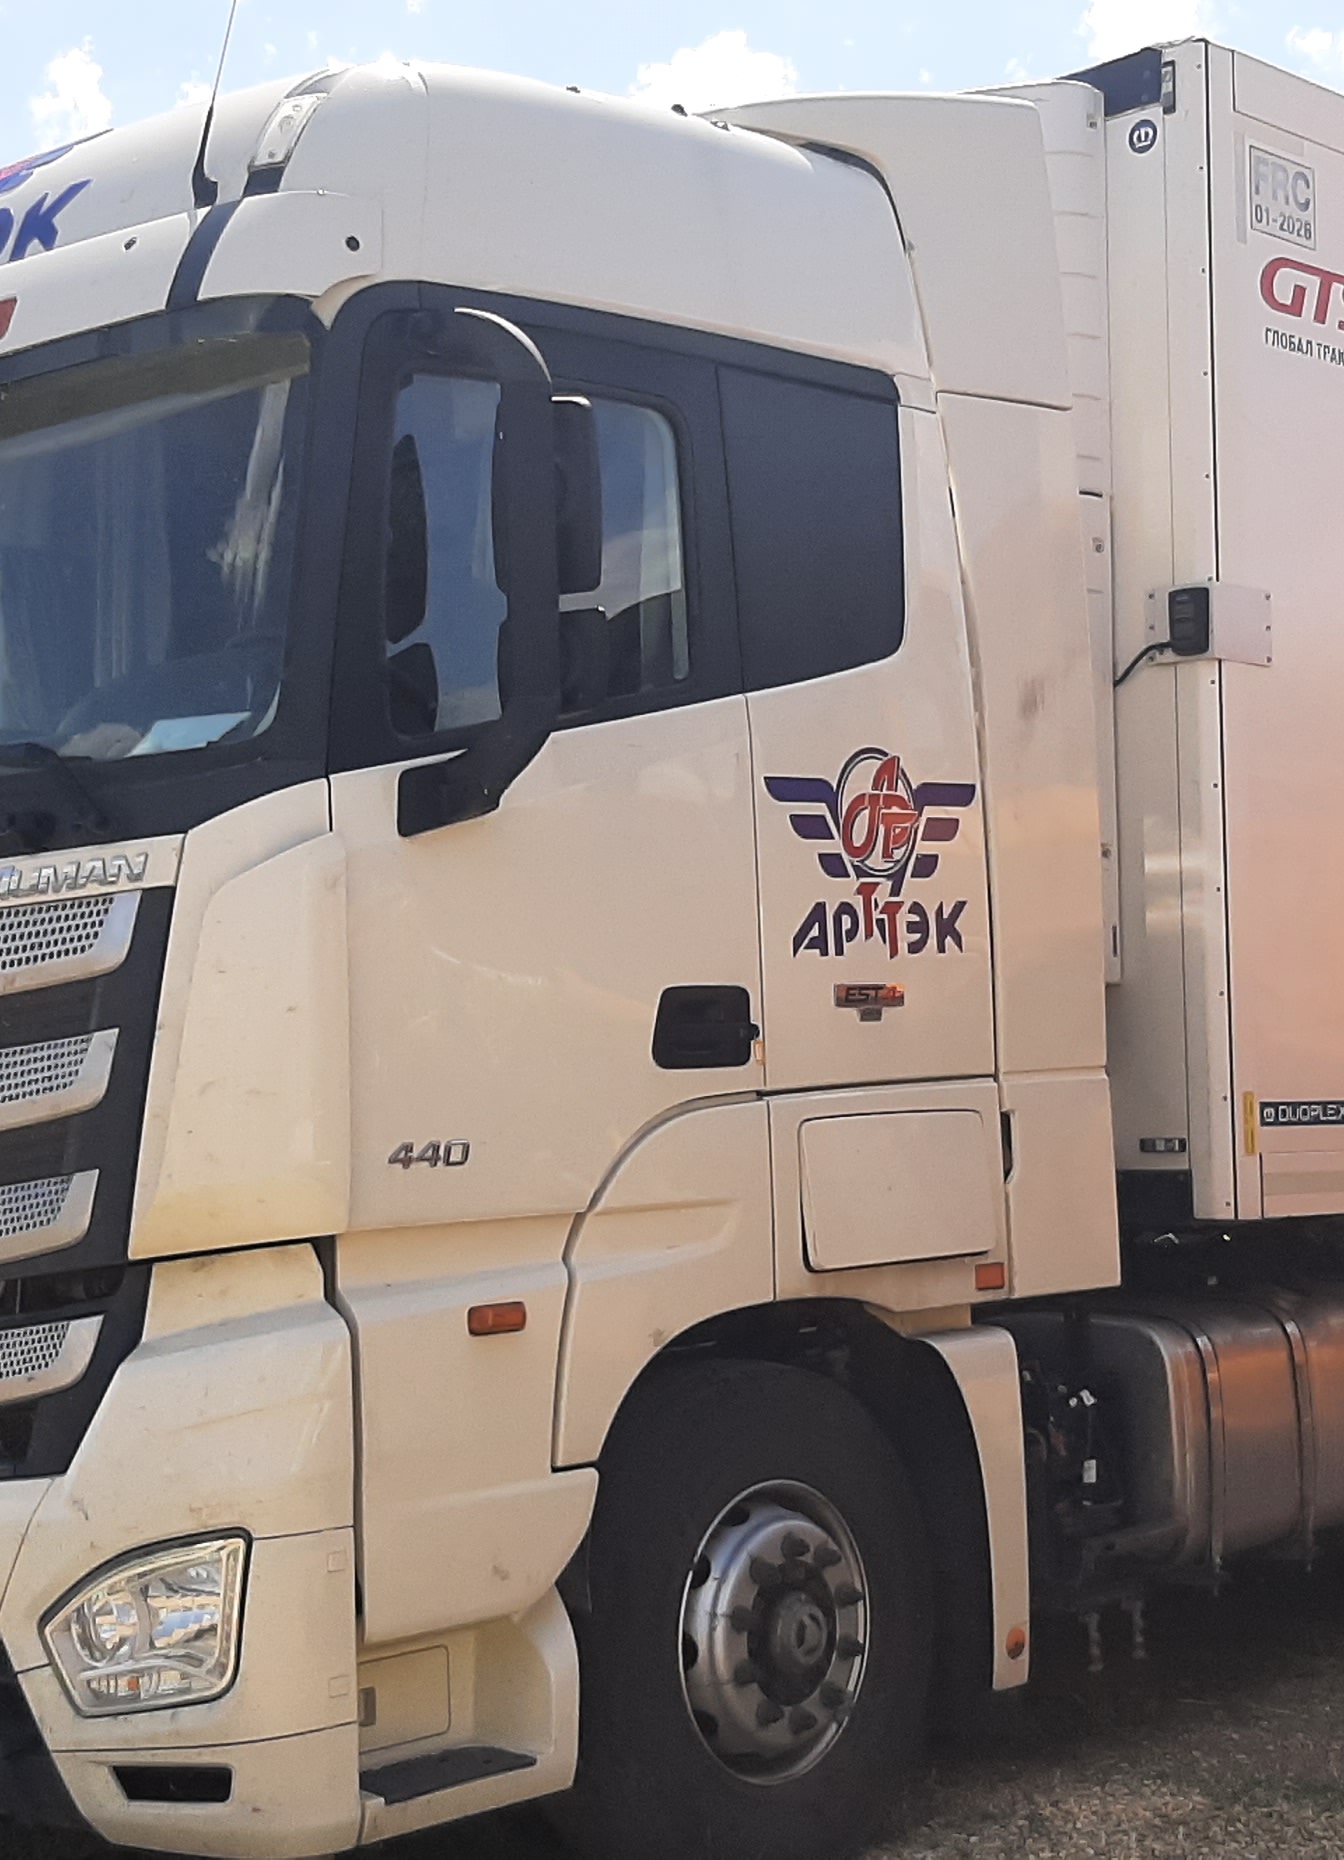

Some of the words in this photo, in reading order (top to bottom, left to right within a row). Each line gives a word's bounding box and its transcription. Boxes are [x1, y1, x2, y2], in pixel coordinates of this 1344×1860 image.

[1253, 155, 1311, 213] FRC
[1264, 326, 1314, 358] ГЛОБАЛ
[387, 1139, 471, 1170] 440
